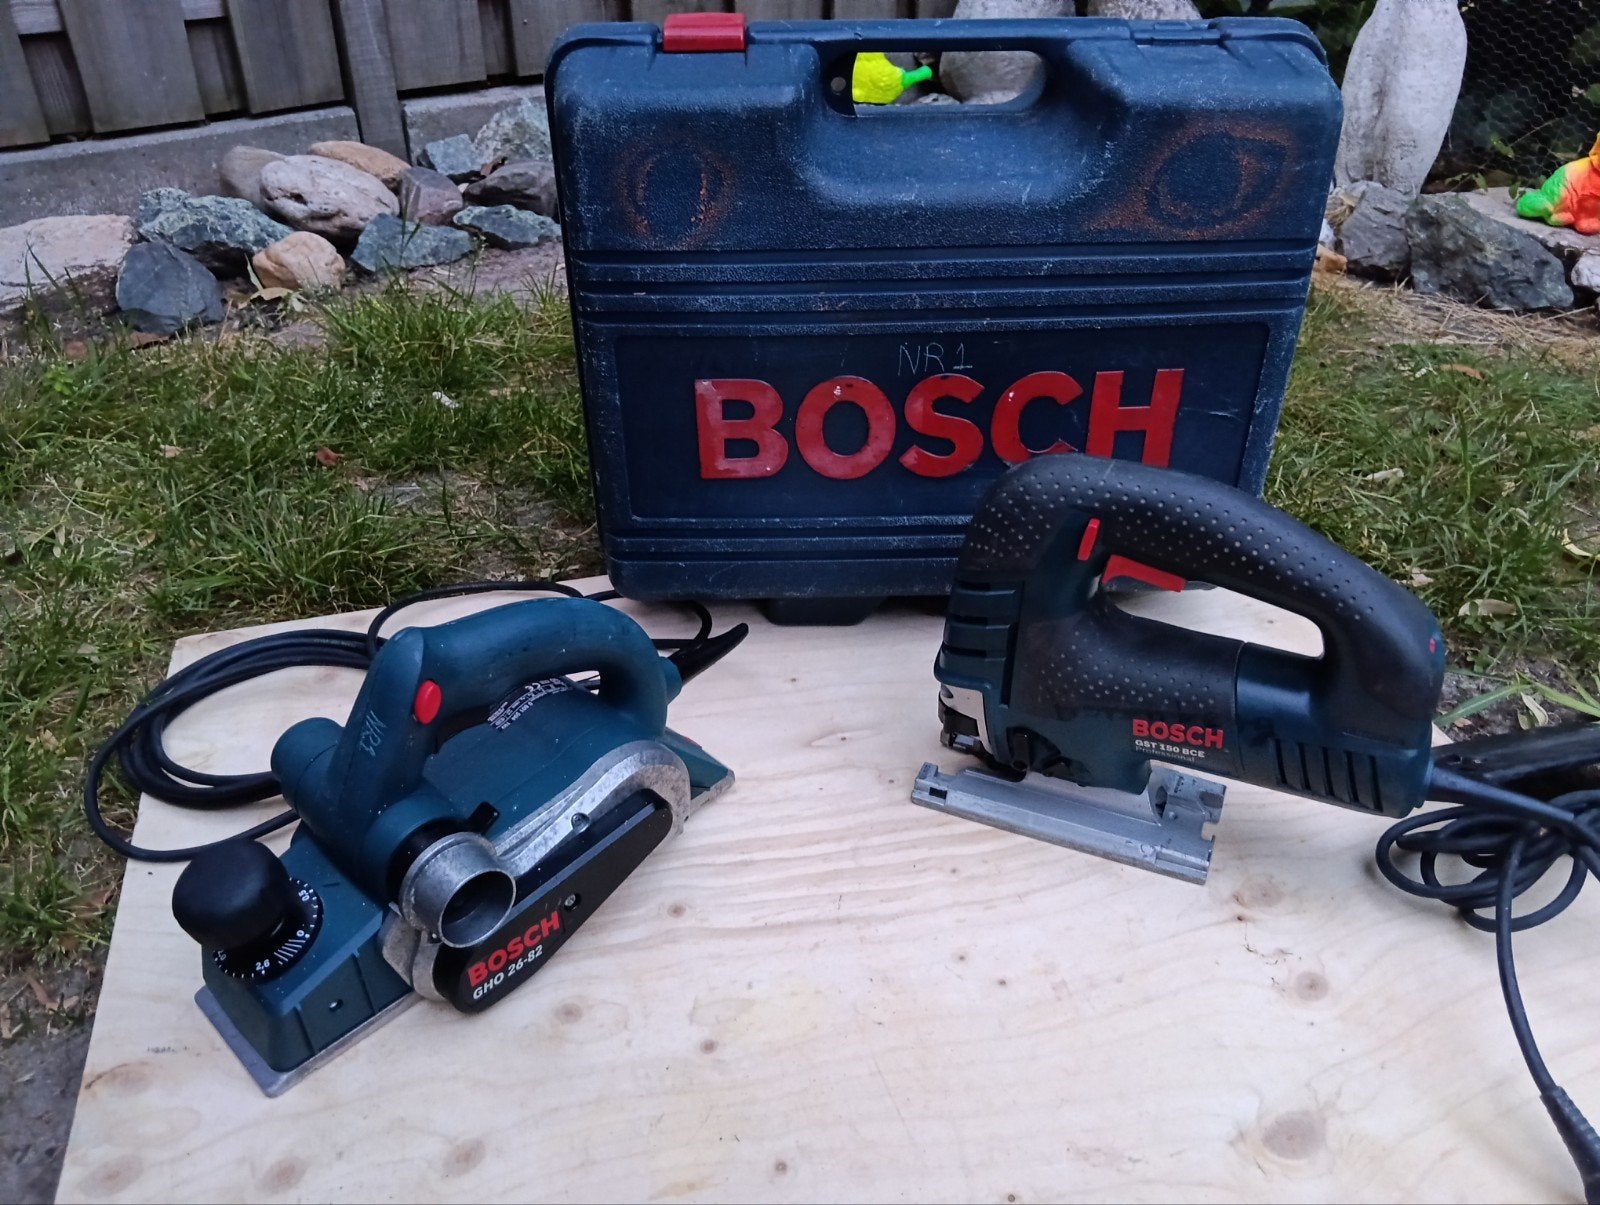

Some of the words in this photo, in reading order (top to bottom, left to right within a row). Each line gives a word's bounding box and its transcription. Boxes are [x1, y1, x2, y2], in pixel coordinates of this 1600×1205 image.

[694, 368, 1185, 480] BOSCH
[1132, 719, 1224, 749] BOSCH
[1135, 739, 1158, 749] GST
[1160, 743, 1180, 753] 150
[1182, 748, 1206, 758] BCE
[1135, 746, 1195, 762] Professional
[468, 910, 560, 987] BOSCH
[473, 972, 505, 1000] GHO
[507, 945, 543, 977] 26-82
